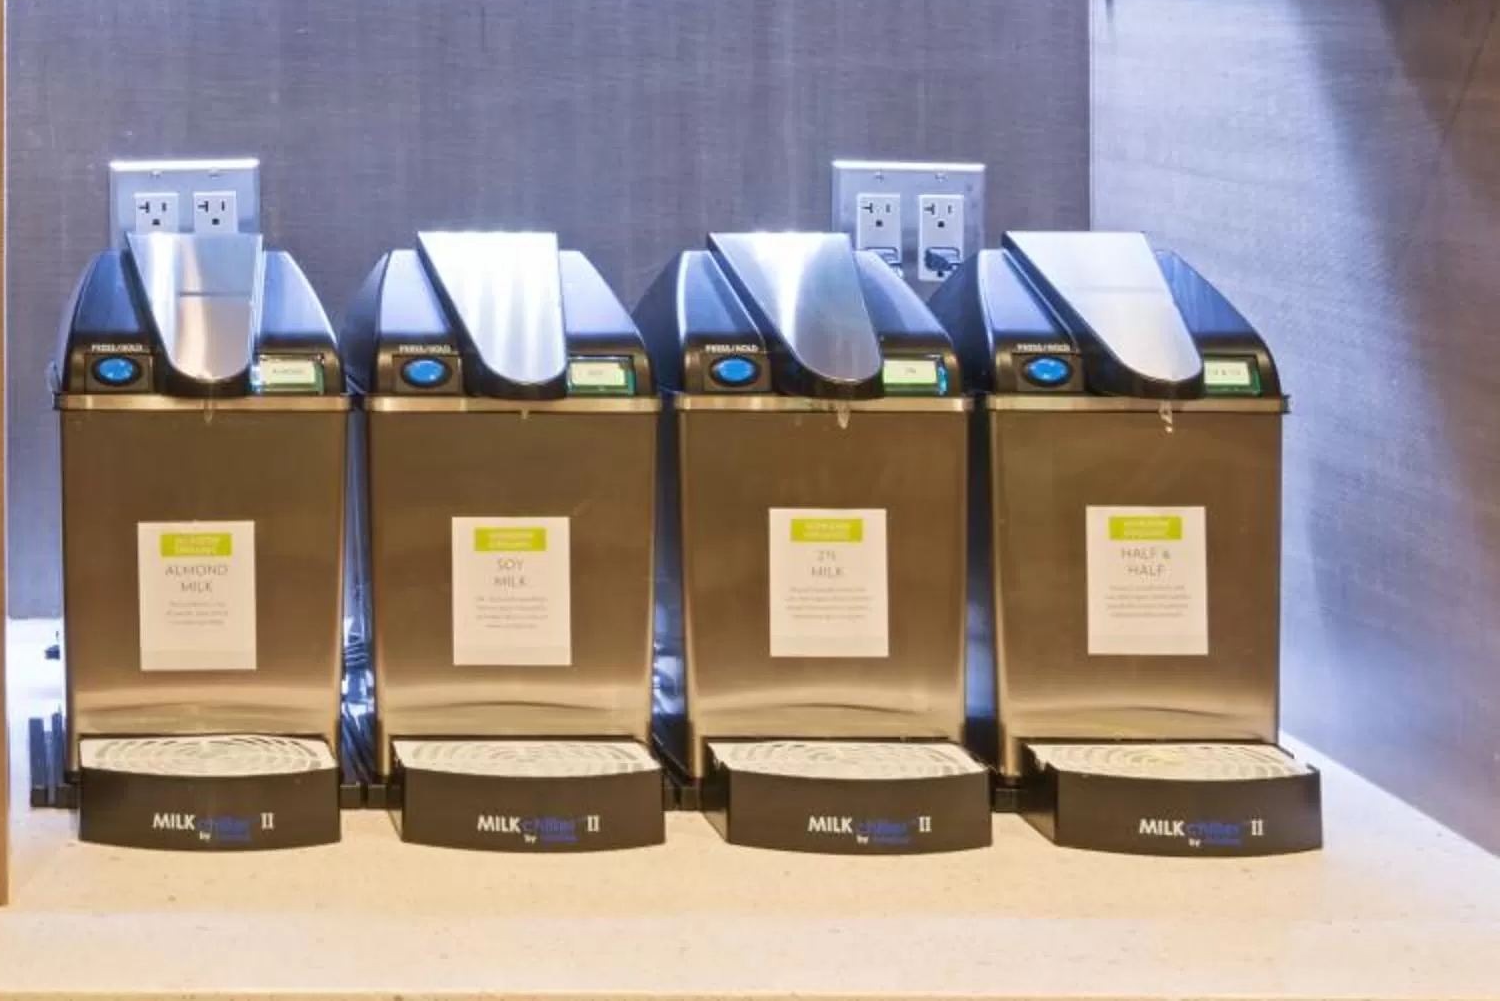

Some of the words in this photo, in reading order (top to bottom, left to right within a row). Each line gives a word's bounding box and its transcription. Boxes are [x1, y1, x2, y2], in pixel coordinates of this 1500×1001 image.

[165, 565, 228, 576] ALMOND
[181, 581, 213, 592] MILK
[152, 812, 196, 830] MILK
[260, 812, 274, 830] II
[477, 814, 521, 833] MILK
[587, 814, 600, 832] II
[807, 815, 853, 834] MILK
[918, 816, 932, 833] II
[1139, 818, 1185, 836] MILK
[1251, 818, 1264, 836] II
